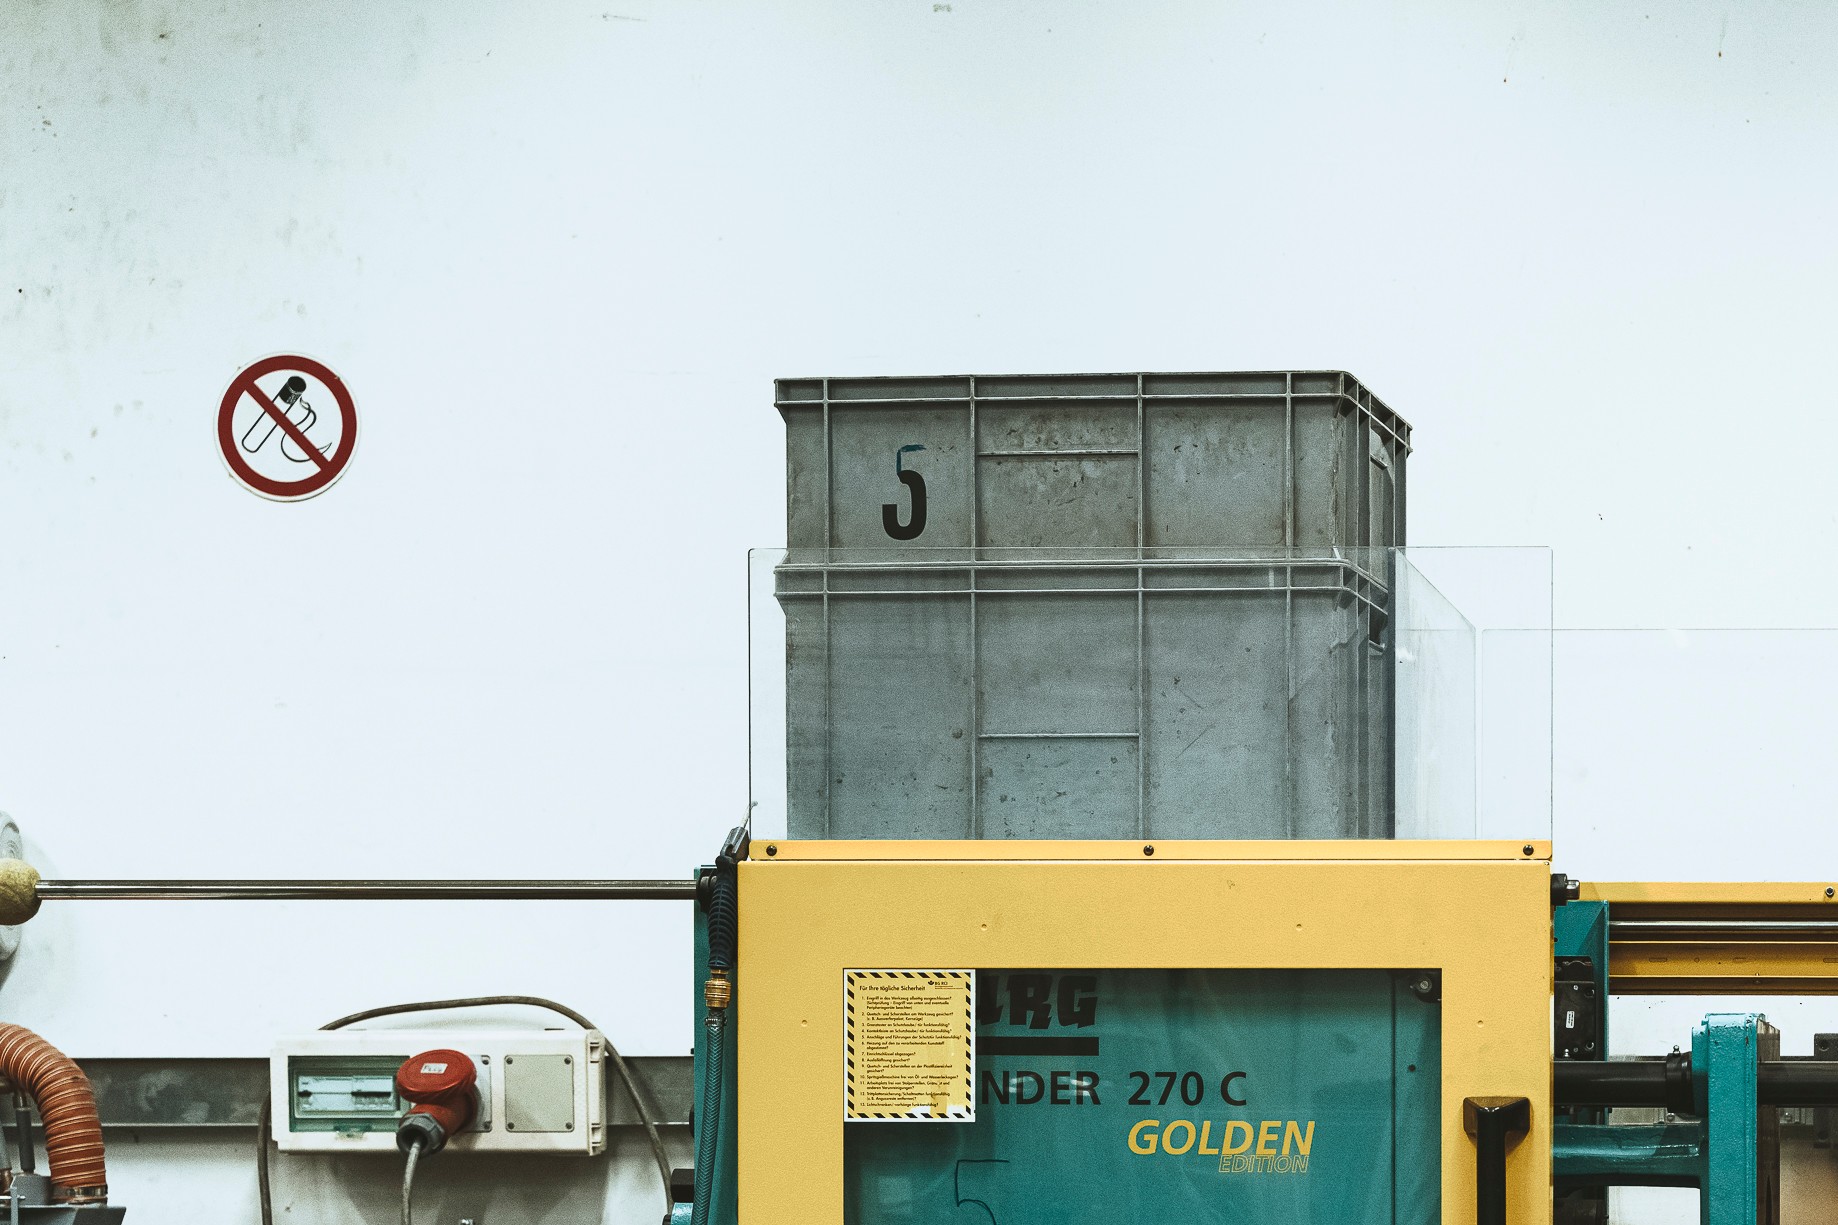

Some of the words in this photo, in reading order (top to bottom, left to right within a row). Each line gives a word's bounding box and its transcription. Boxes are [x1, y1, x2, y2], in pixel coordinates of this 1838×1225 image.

[882, 443, 927, 541] 5
[981, 1070, 1101, 1106] NDER
[1128, 1071, 1205, 1106] 270
[1220, 1071, 1247, 1106] C
[1127, 1119, 1316, 1155] GOLDEN
[1218, 1154, 1309, 1173] EDITION
